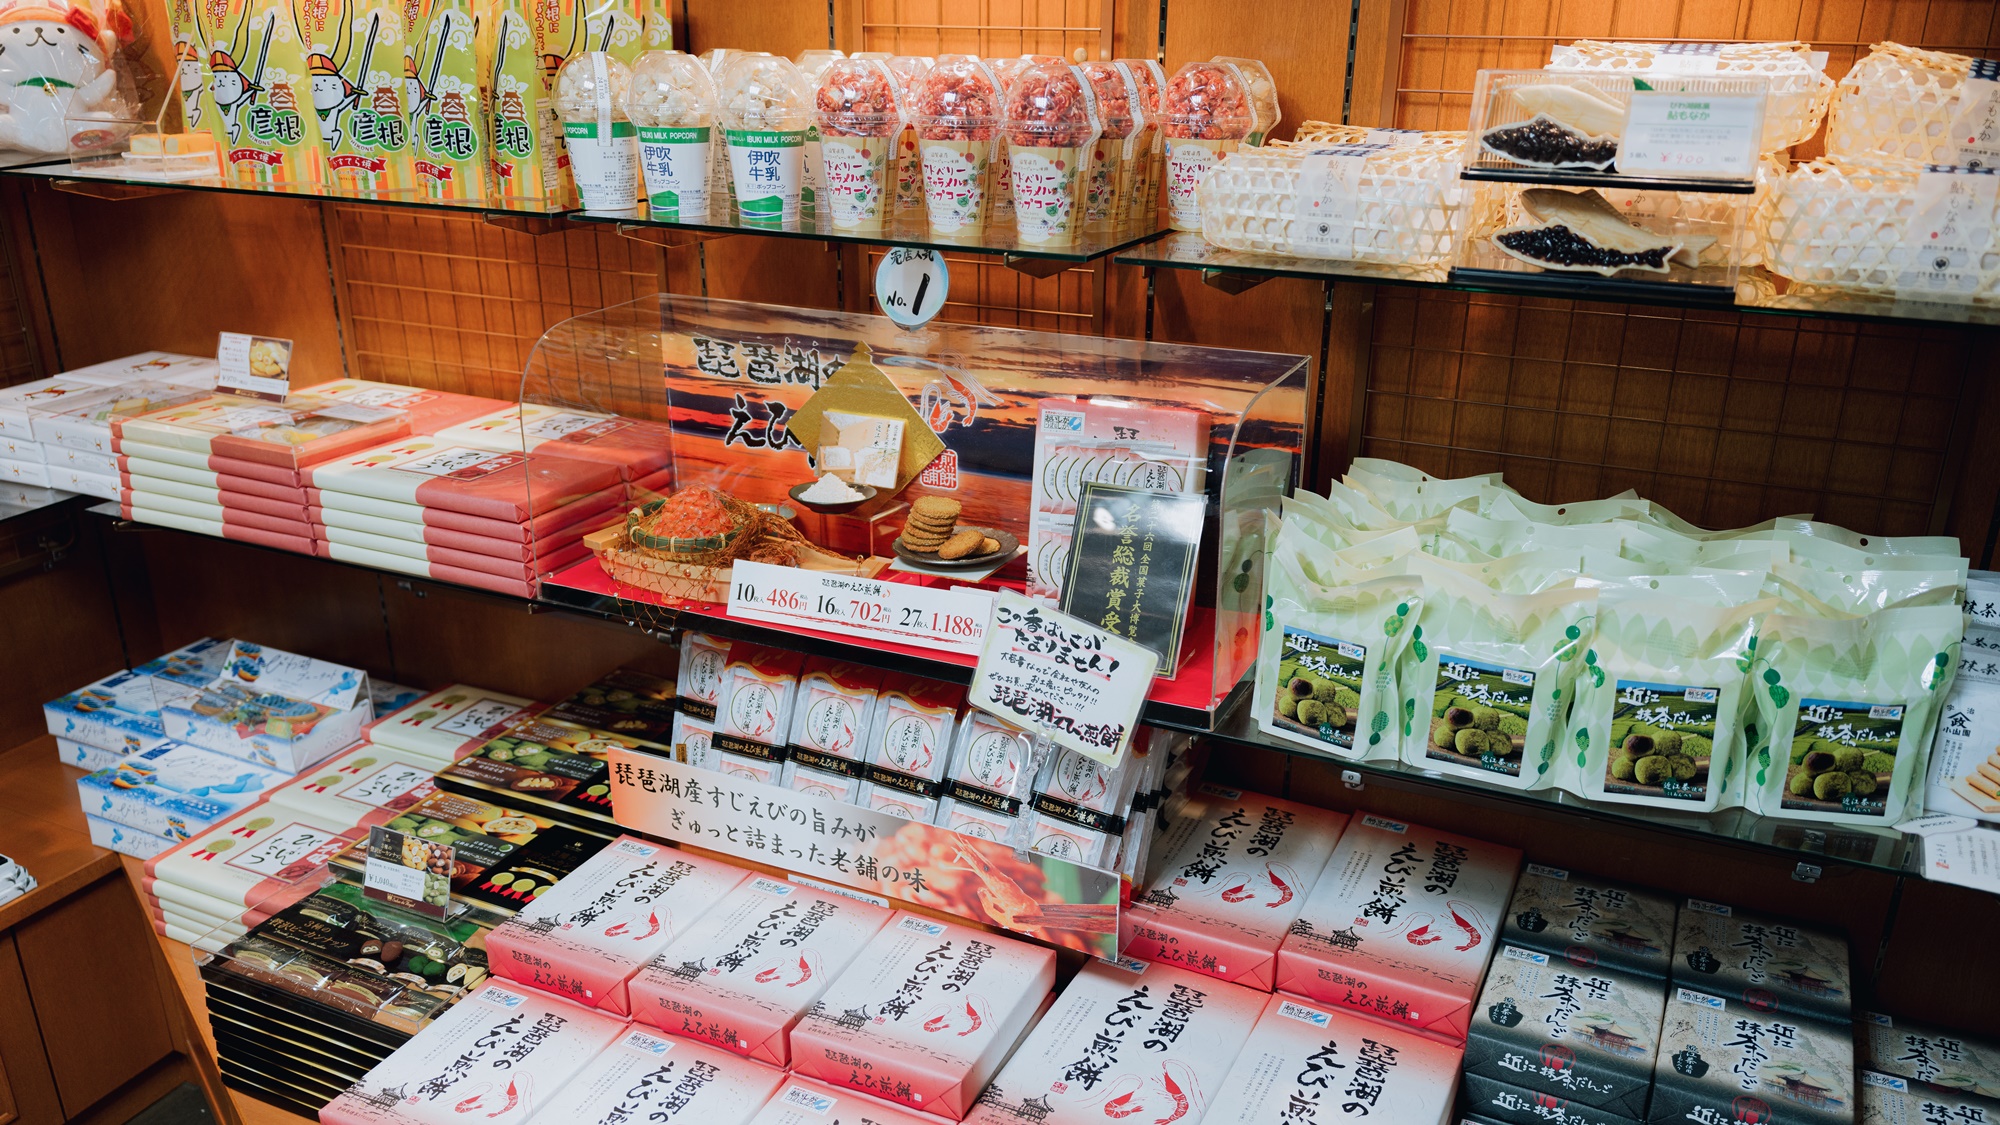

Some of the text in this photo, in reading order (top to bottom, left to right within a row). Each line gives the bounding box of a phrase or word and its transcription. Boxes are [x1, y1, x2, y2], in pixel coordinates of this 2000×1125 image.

[250, 108, 302, 141] 彦根
[1667, 111, 1710, 120] 鮎もなか
[353, 112, 404, 147] 彦根
[426, 118, 473, 155] 彦根
[567, 127, 588, 135] POPCORN
[641, 131, 698, 140] IBUKI MILK POPCORN
[746, 134, 802, 143] IBUKI MILK POPCORN
[644, 145, 671, 161] 伊吹
[747, 150, 781, 166] 伊吹
[646, 162, 673, 177] 牛乳
[653, 178, 680, 186] ポップコーン
[749, 166, 780, 182] 牛乳
[924, 164, 966, 176] アドベリー
[1013, 171, 1056, 183] アドベリー
[1321, 159, 1339, 205] 鮎もなか
[1942, 180, 1965, 236] 鮎もなか
[891, 248, 934, 265] 売店人気
[886, 273, 931, 316] No. 1
[1143, 499, 1159, 552] 第二十六回
[821, 577, 882, 597] 琵琶湖のえび煎餅
[736, 582, 765, 604] 10枚入
[766, 587, 808, 611] 486円
[817, 594, 846, 618] 16枚入
[849, 599, 891, 624] 702円
[899, 607, 929, 630] 27枚入
[930, 612, 983, 639] 1,188円
[997, 607, 1107, 651] この香ばしさが
[1015, 628, 1120, 678] たまりません!
[1286, 633, 1320, 654] 近江
[1299, 654, 1361, 681] 抹茶だんご
[1441, 661, 1481, 682] 近江
[1457, 683, 1529, 708] 抹茶だんご
[1618, 687, 1661, 707] 近江
[989, 684, 1126, 755] 琵琶湖えび煎餅
[1635, 706, 1712, 731] 抹茶だんご
[1801, 704, 1844, 723] 近江
[1951, 716, 1967, 729] 政
[1817, 723, 1897, 748] 抹茶だんご
[1943, 727, 1972, 738] 小山園
[615, 762, 876, 843] 琵琶湖産すじえびの旨みが
[1246, 806, 1296, 858] 琵琶湖の
[671, 808, 930, 893] ぎゅっと詰まった老舗の味
[1424, 840, 1470, 897] 琵琶湖の
[633, 860, 697, 905] 琵琶湖の
[1600, 889, 1628, 910] 近江
[304, 920, 332, 933] 3種の
[780, 899, 839, 949] 琵琶湖の
[1562, 886, 1600, 941] 抹茶だんご
[1133, 924, 1179, 946] 琵琶湖の
[1769, 926, 1798, 948] 近江
[512, 950, 551, 971] 琵琶湖の
[1156, 946, 1218, 974] えび煎餅
[1732, 923, 1773, 983] 抹茶だんご
[942, 939, 997, 994] 琵琶湖の
[1318, 968, 1368, 990] 琵琶湖の
[533, 971, 585, 1000] えび煎餅
[1583, 977, 1613, 1001] 近江
[658, 996, 703, 1019] 琵琶湖の
[1143, 983, 1208, 1053] 琵琶湖の
[1342, 991, 1410, 1020] えび煎餅
[1540, 974, 1582, 1039] 抹茶だんご
[492, 1011, 568, 1070] 琵琶湖の
[681, 1017, 738, 1049] えび煎餅
[1765, 1023, 1796, 1049] 近江
[825, 1048, 874, 1071] 琵琶湖の
[1723, 1019, 1767, 1090] 抹茶だんご
[1933, 1038, 1962, 1062] 近江
[848, 1069, 913, 1102] えび煎餅
[1342, 1037, 1400, 1118] 琵琶湖の
[649, 1059, 721, 1123] 琵琶湖の
